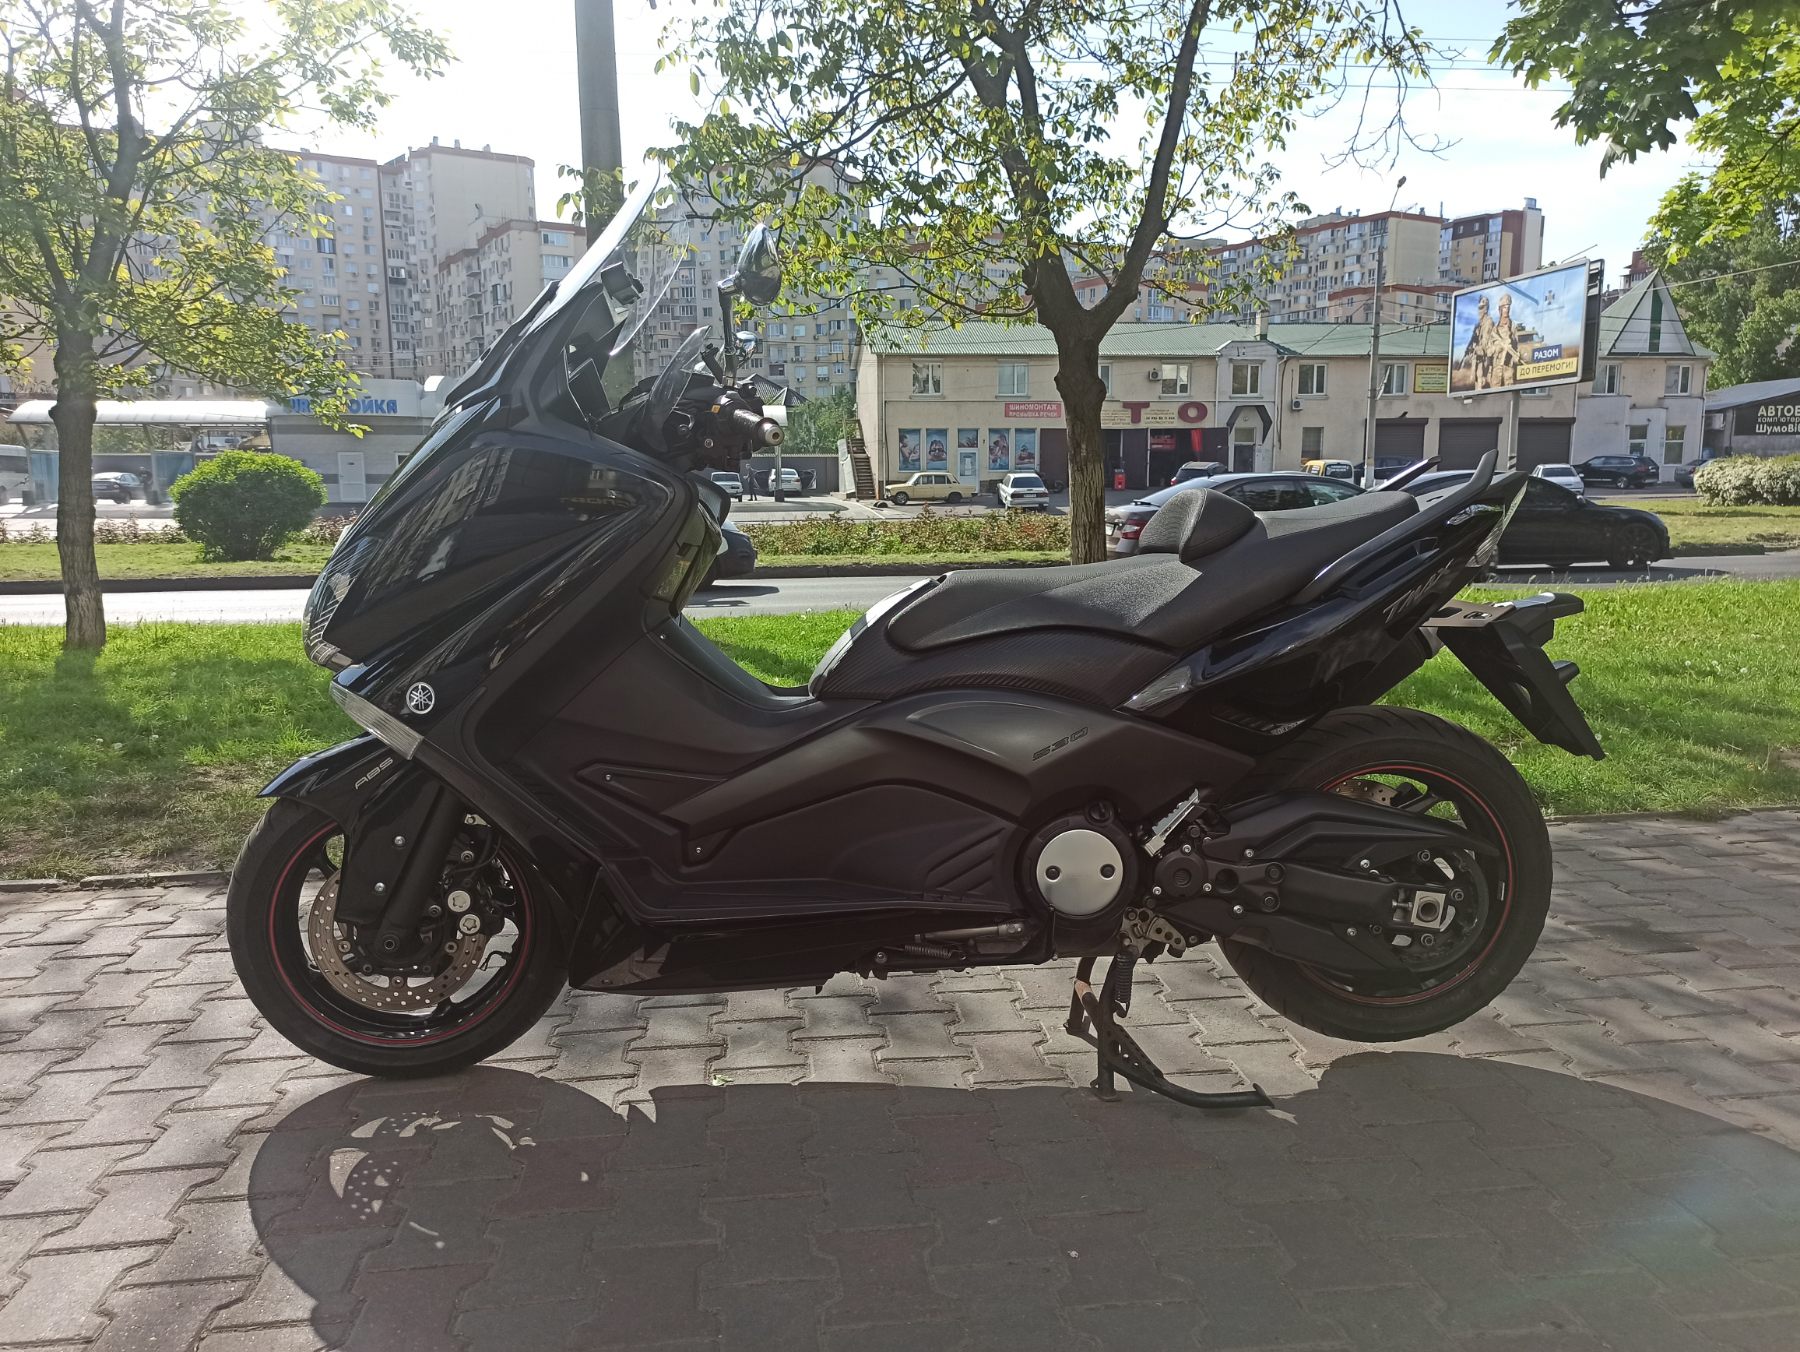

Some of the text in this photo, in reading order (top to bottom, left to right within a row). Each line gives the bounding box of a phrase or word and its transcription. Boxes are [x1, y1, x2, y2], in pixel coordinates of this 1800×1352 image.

[1533, 347, 1559, 360] РАЗОМ
[1520, 362, 1574, 376] ДО ПЕРЕМОГИ!
[1009, 403, 1057, 411] ШИНОМОНТАЖ
[1032, 726, 1089, 761] 530
[355, 757, 394, 790] ABS
